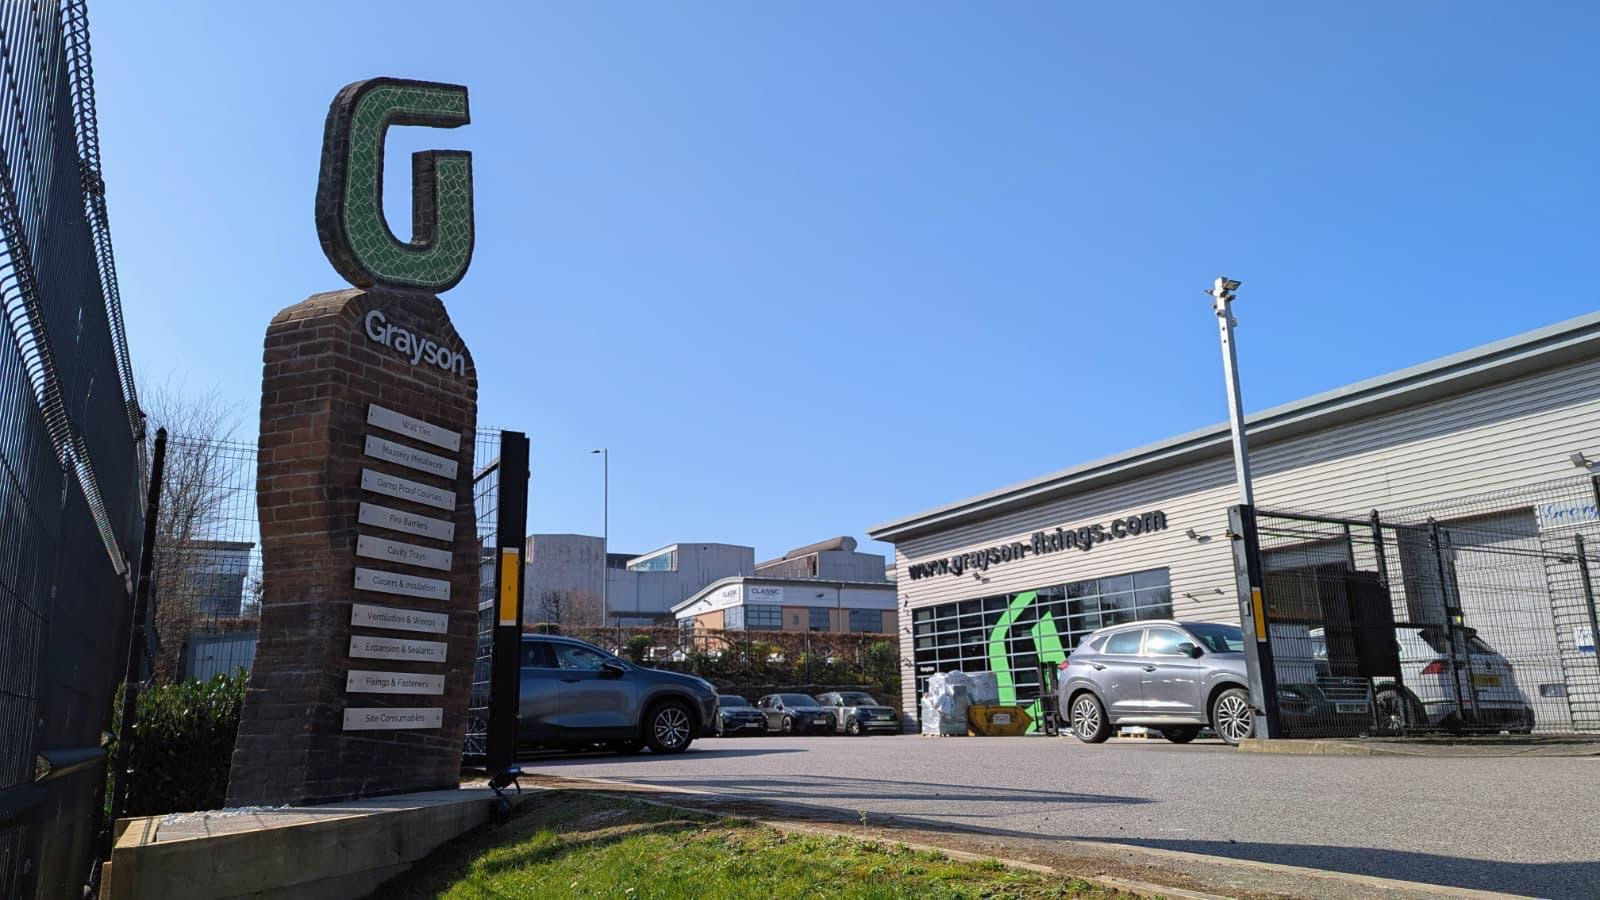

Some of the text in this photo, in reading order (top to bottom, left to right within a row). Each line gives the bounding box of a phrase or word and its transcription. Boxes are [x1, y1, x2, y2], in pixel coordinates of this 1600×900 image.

[316, 77, 475, 293] G
[365, 310, 465, 376] Grayson
[402, 419, 432, 437] Wall Ties
[383, 444, 443, 469] Masonry Metalwork
[377, 479, 442, 501] Damp Proof Courses
[389, 514, 428, 530] Fire Barriers
[387, 546, 426, 561] Cavity Trays
[908, 510, 1168, 580] www.grayson-fixings.com
[373, 575, 399, 587] Closers
[405, 580, 436, 593] Insulation
[752, 587, 780, 595] CLASSIC
[367, 611, 405, 623] Ventilation
[365, 643, 400, 655] Expansion
[407, 646, 434, 656] Sealants
[366, 677, 390, 688] Fixings
[397, 678, 429, 688] Fasteners
[365, 713, 425, 723] Site Consumables
